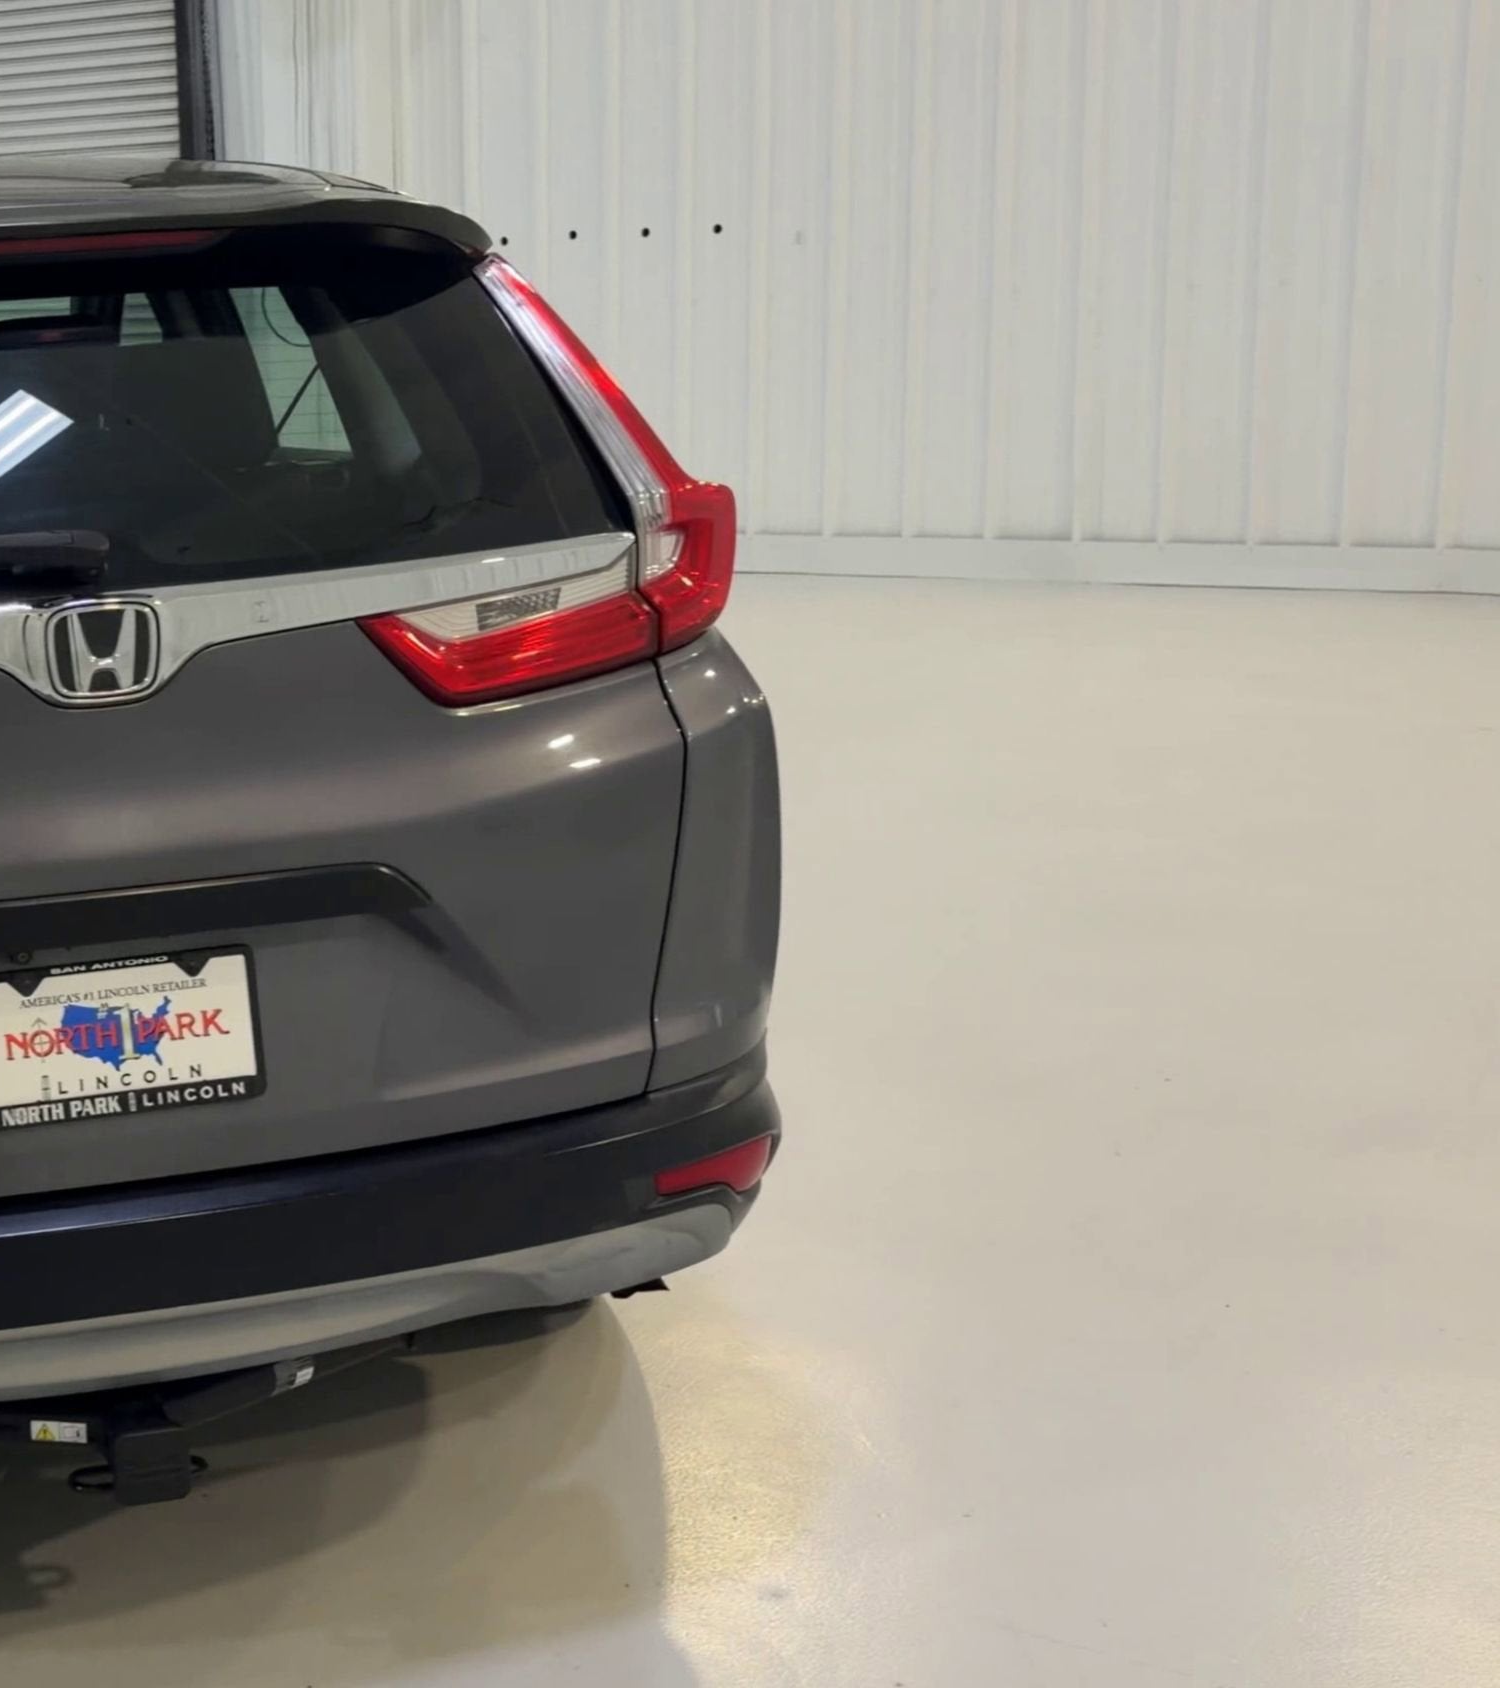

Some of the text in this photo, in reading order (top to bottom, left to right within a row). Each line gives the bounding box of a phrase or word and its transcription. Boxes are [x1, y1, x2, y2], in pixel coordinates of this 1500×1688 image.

[50, 955, 169, 975] SAN ANTONIO
[20, 992, 82, 1009] AMERICA'S
[97, 984, 152, 1001] LINCOLN
[152, 978, 208, 993] RETAILER
[4, 1023, 119, 1060] NORTH
[136, 1008, 231, 1045] PARK
[56, 1063, 204, 1095] LINCOLN
[1, 1080, 247, 1128] NORTH PARK LINCOLN
